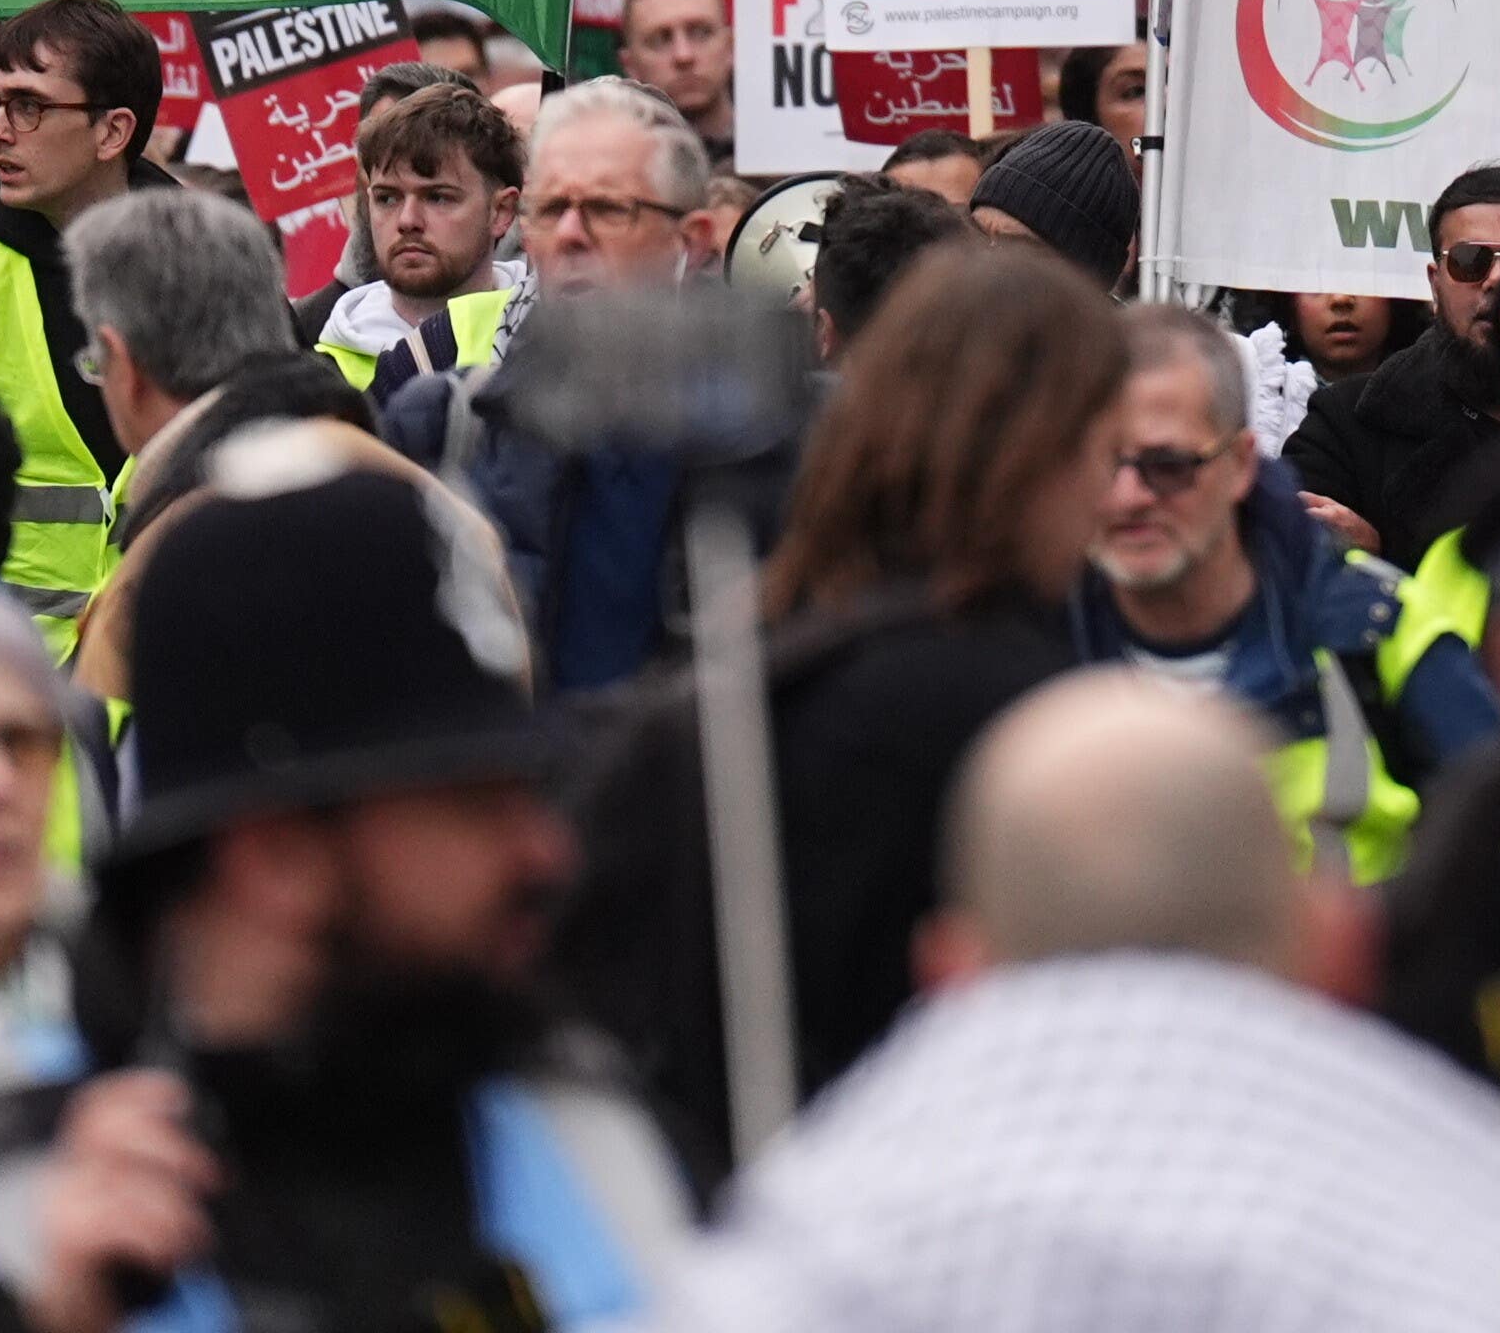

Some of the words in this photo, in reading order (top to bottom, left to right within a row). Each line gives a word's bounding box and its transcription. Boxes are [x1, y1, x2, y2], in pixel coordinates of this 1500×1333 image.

[211, 0, 398, 89] PALESTINE
[884, 5, 1079, 24] www.palestinecampaign.org
[773, 42, 838, 108] NO
